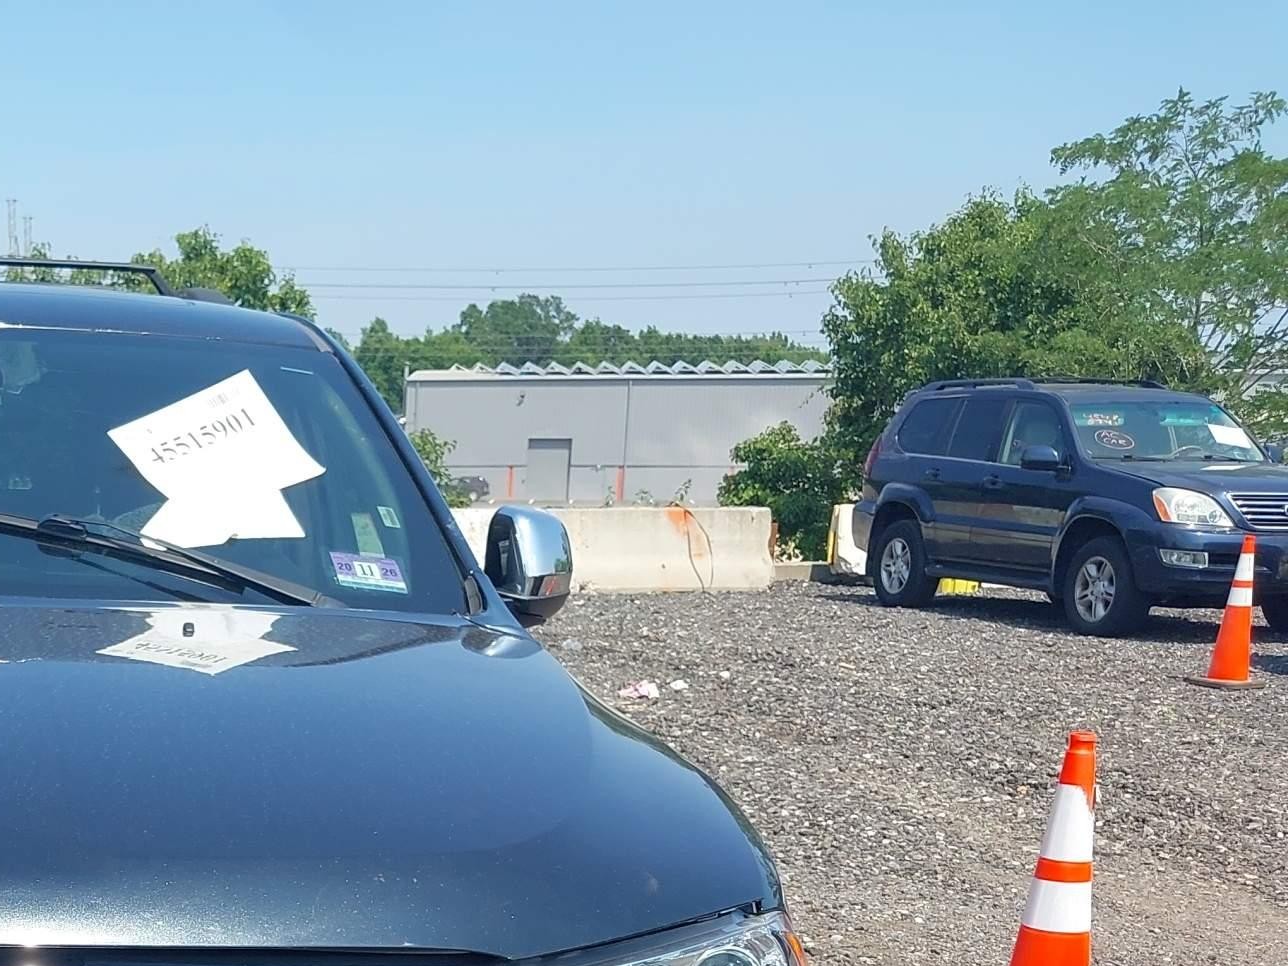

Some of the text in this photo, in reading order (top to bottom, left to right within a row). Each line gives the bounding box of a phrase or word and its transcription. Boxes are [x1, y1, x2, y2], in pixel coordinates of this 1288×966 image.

[150, 407, 255, 464] 45515901
[336, 562, 398, 577] 20 11 26
